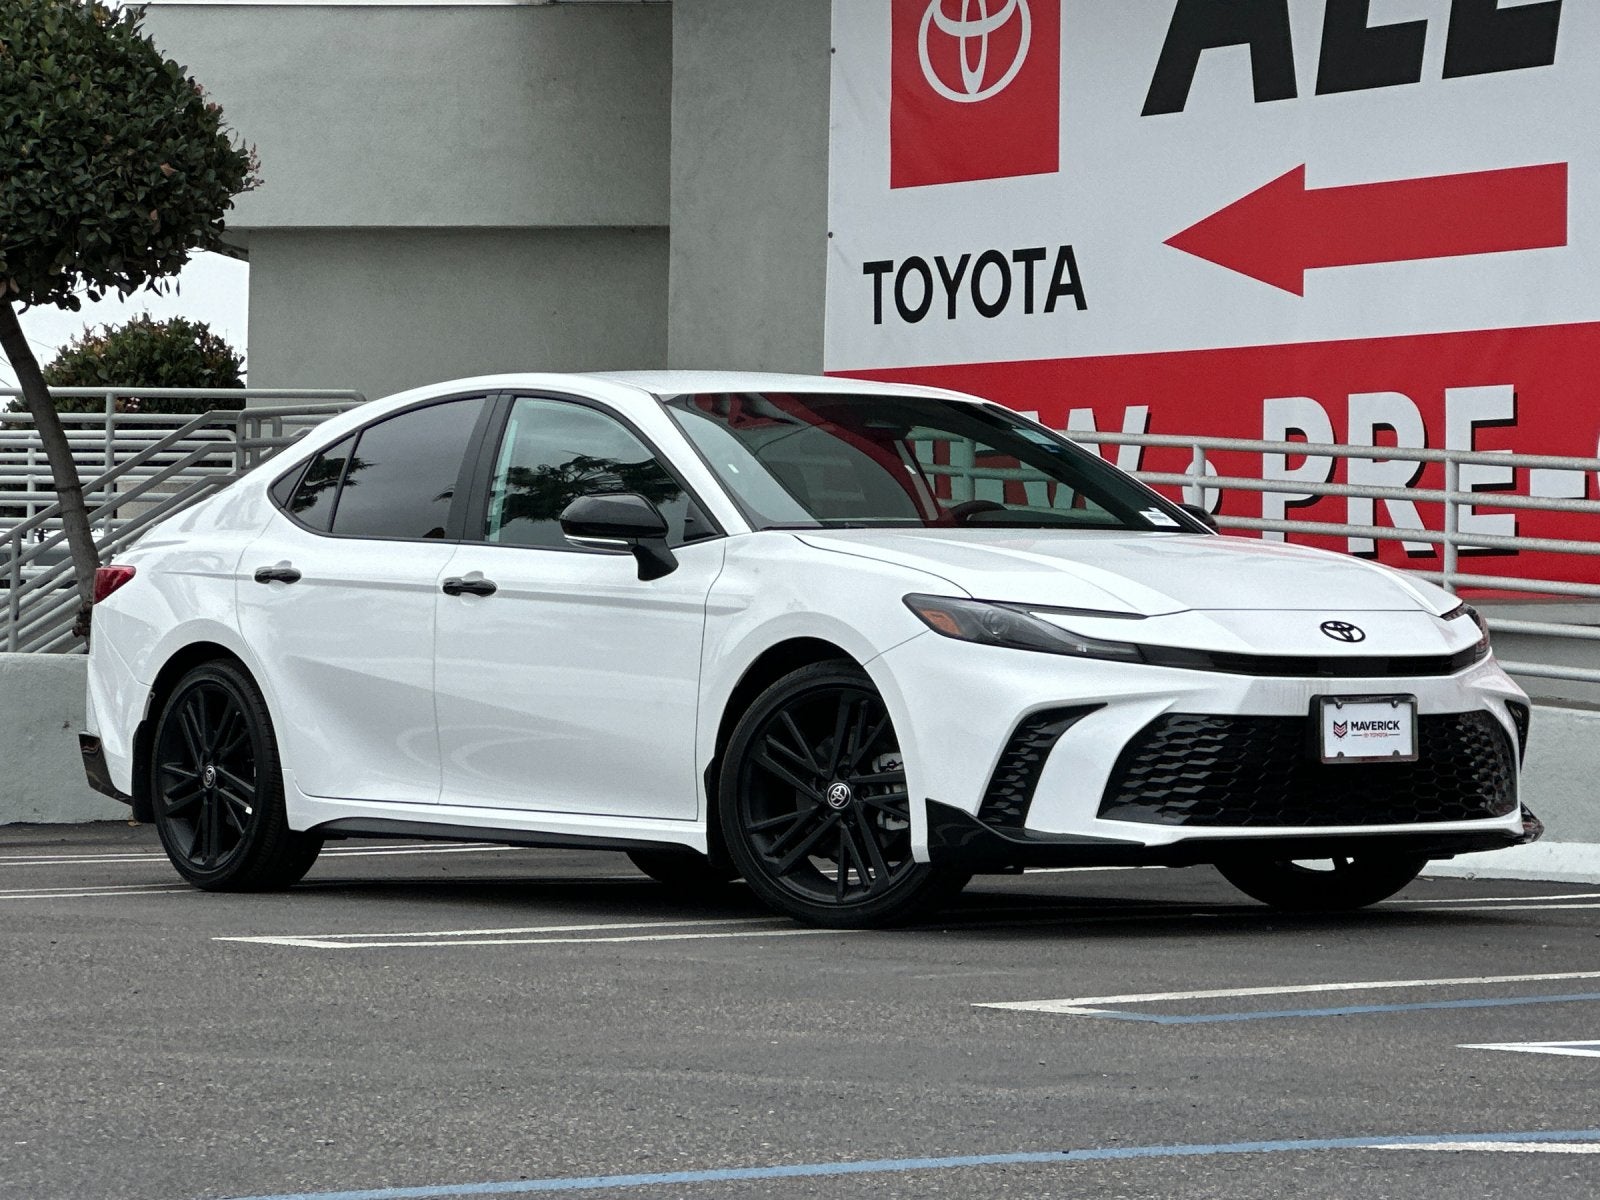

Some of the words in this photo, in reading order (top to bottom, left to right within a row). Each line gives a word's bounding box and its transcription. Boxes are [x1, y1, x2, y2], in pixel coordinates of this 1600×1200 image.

[863, 245, 1088, 325] TOYOTA
[1262, 384, 1600, 558] PRE-
[1350, 720, 1400, 731] MAVERICK
